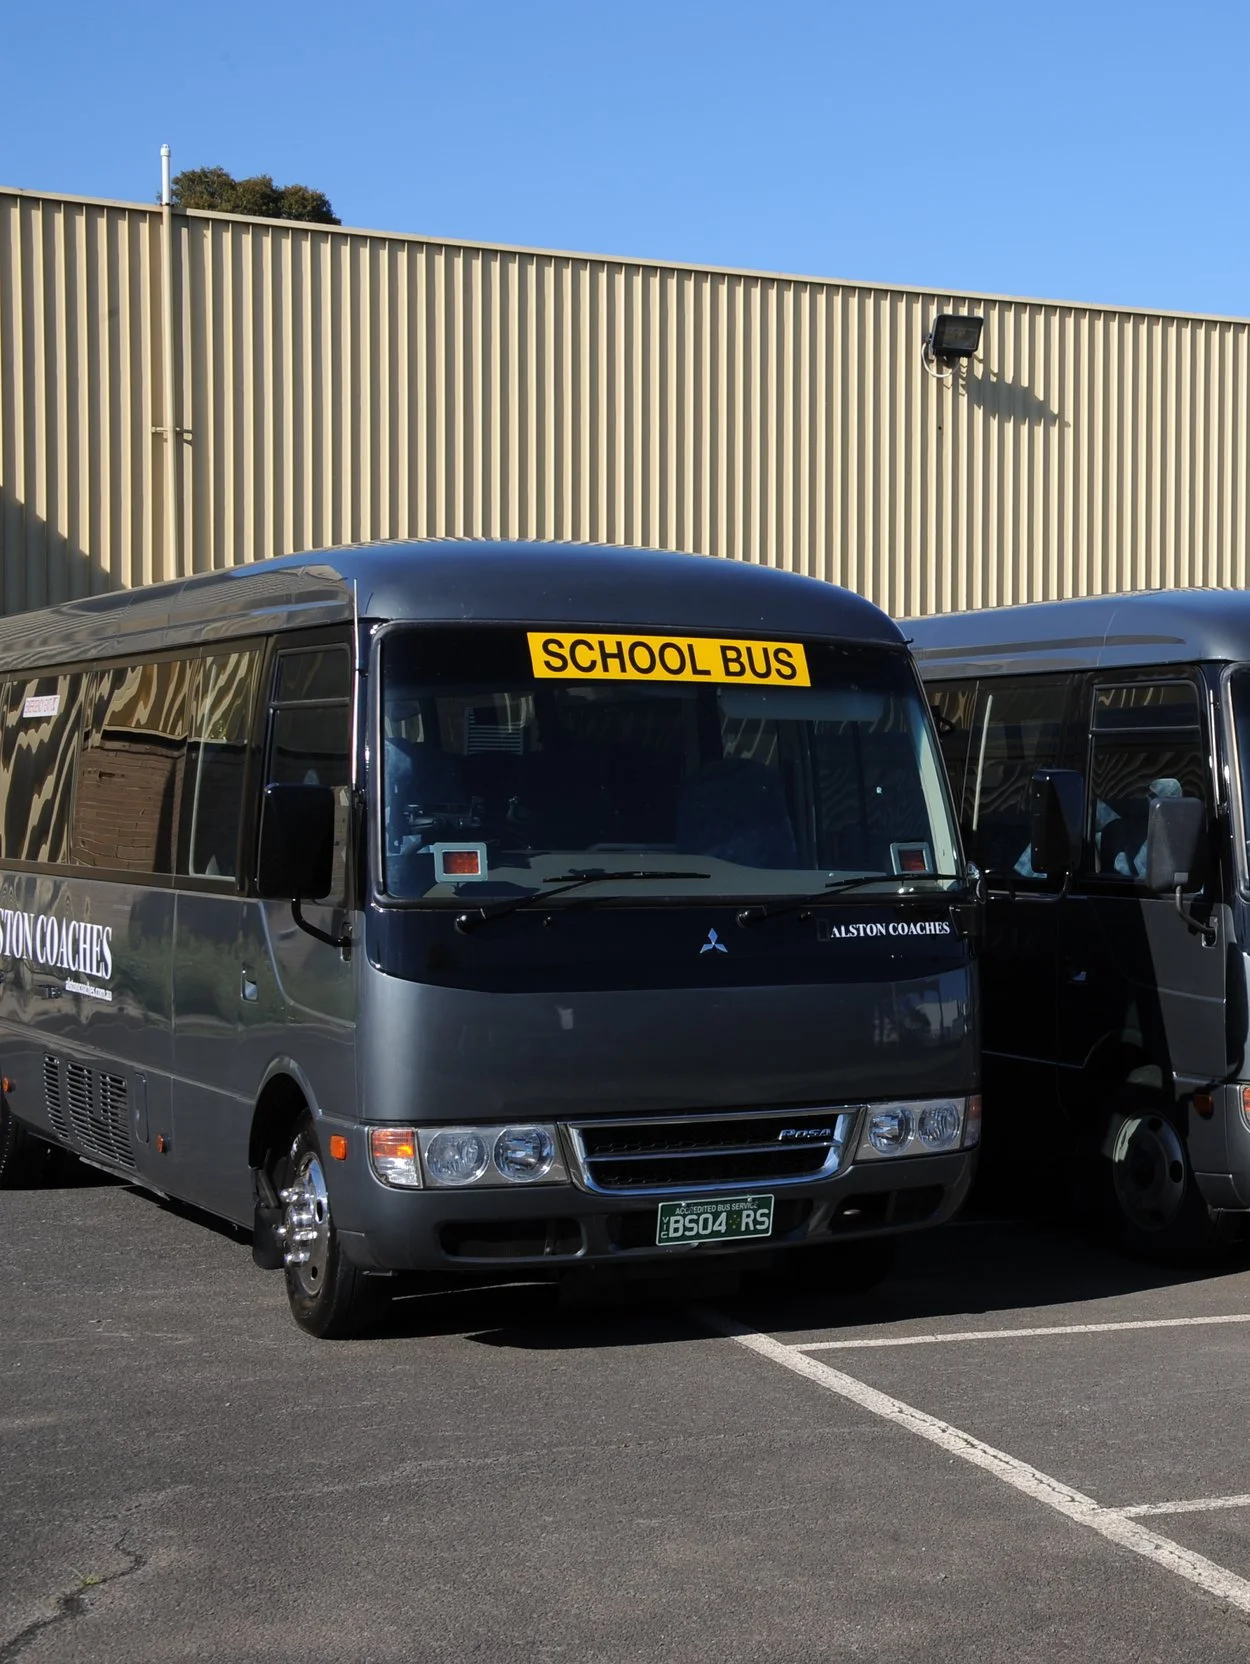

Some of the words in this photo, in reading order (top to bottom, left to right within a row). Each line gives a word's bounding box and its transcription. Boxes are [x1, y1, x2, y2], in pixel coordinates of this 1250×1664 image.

[542, 638, 712, 676] SCHOOL
[720, 645, 797, 680] BUS
[830, 922, 887, 938] ALSTON
[888, 921, 951, 936] COACHES
[35, 914, 113, 980] COACHES
[717, 1202, 731, 1212] BUS
[668, 1211, 728, 1238] BS04
[740, 1208, 770, 1232] RS
